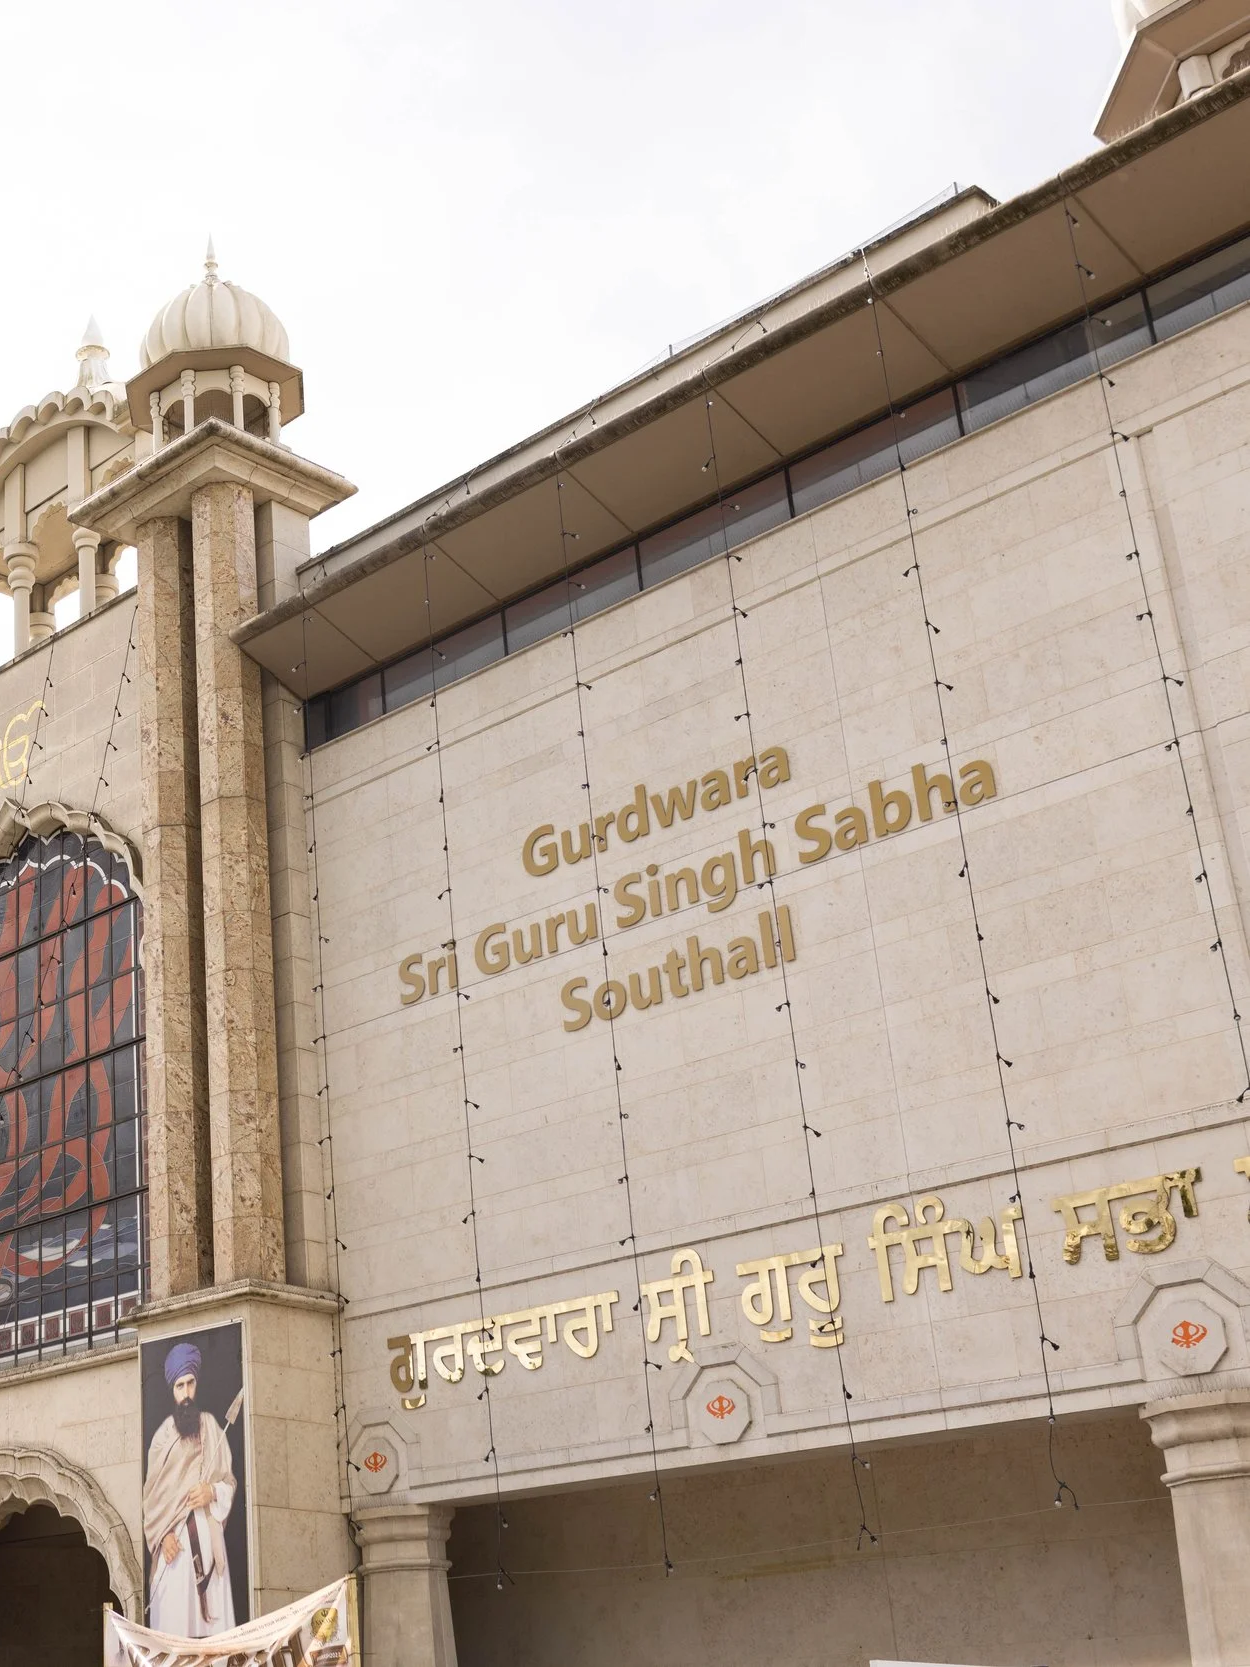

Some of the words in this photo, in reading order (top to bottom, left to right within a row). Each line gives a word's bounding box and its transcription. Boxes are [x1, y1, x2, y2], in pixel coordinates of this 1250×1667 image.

[398, 941, 458, 1005] Sri
[474, 902, 598, 976] Guru
[613, 828, 777, 929] Singh
[794, 758, 998, 865] Sabha
[522, 744, 791, 877] Gurdwara
[560, 904, 797, 1033] Southall
[387, 1289, 619, 1410] ਗੁਰਦਵਾਰਾ
[736, 1242, 844, 1348] ਗੁਰੂ
[867, 1195, 1024, 1303] ਸਿੰਘ
[1053, 1166, 1202, 1266] ਸਭਾ
